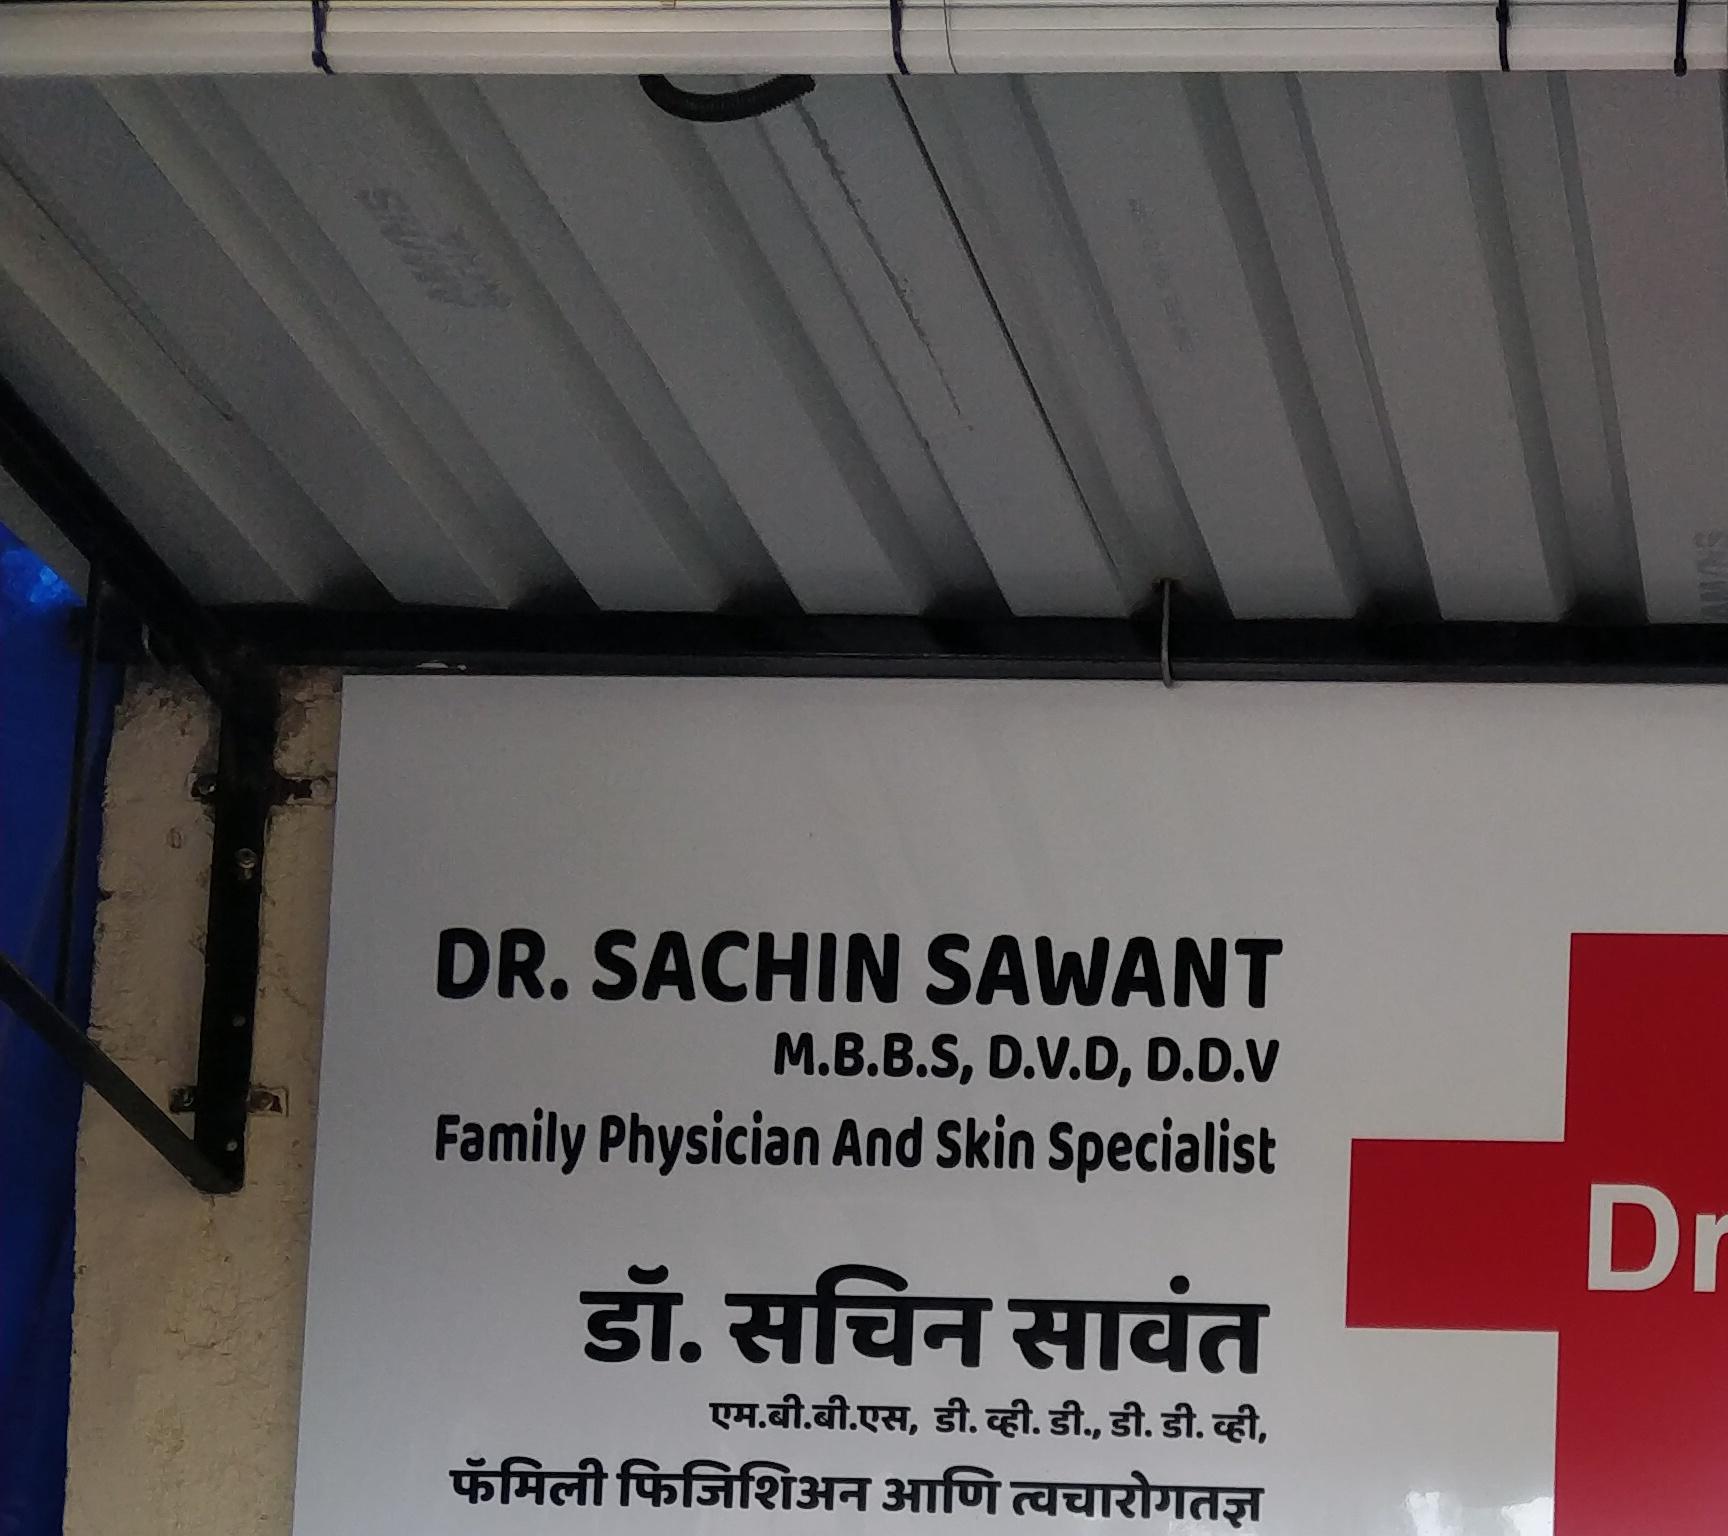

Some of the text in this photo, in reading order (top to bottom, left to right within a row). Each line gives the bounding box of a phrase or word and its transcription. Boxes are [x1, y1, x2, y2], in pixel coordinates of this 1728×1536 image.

[436, 927, 1284, 1009] DR. SACHIN SAWANT
[773, 1031, 1280, 1088] M.B.B.S, D.V.D, D.D.V
[435, 1106, 1277, 1184] Family Physician And Skin Specialist
[579, 1263, 1271, 1375] डॉ. सचिन सावंत
[448, 1455, 1266, 1529] फॅमिली फिजिशिअन आणि त्वचारोगतज्ञ
